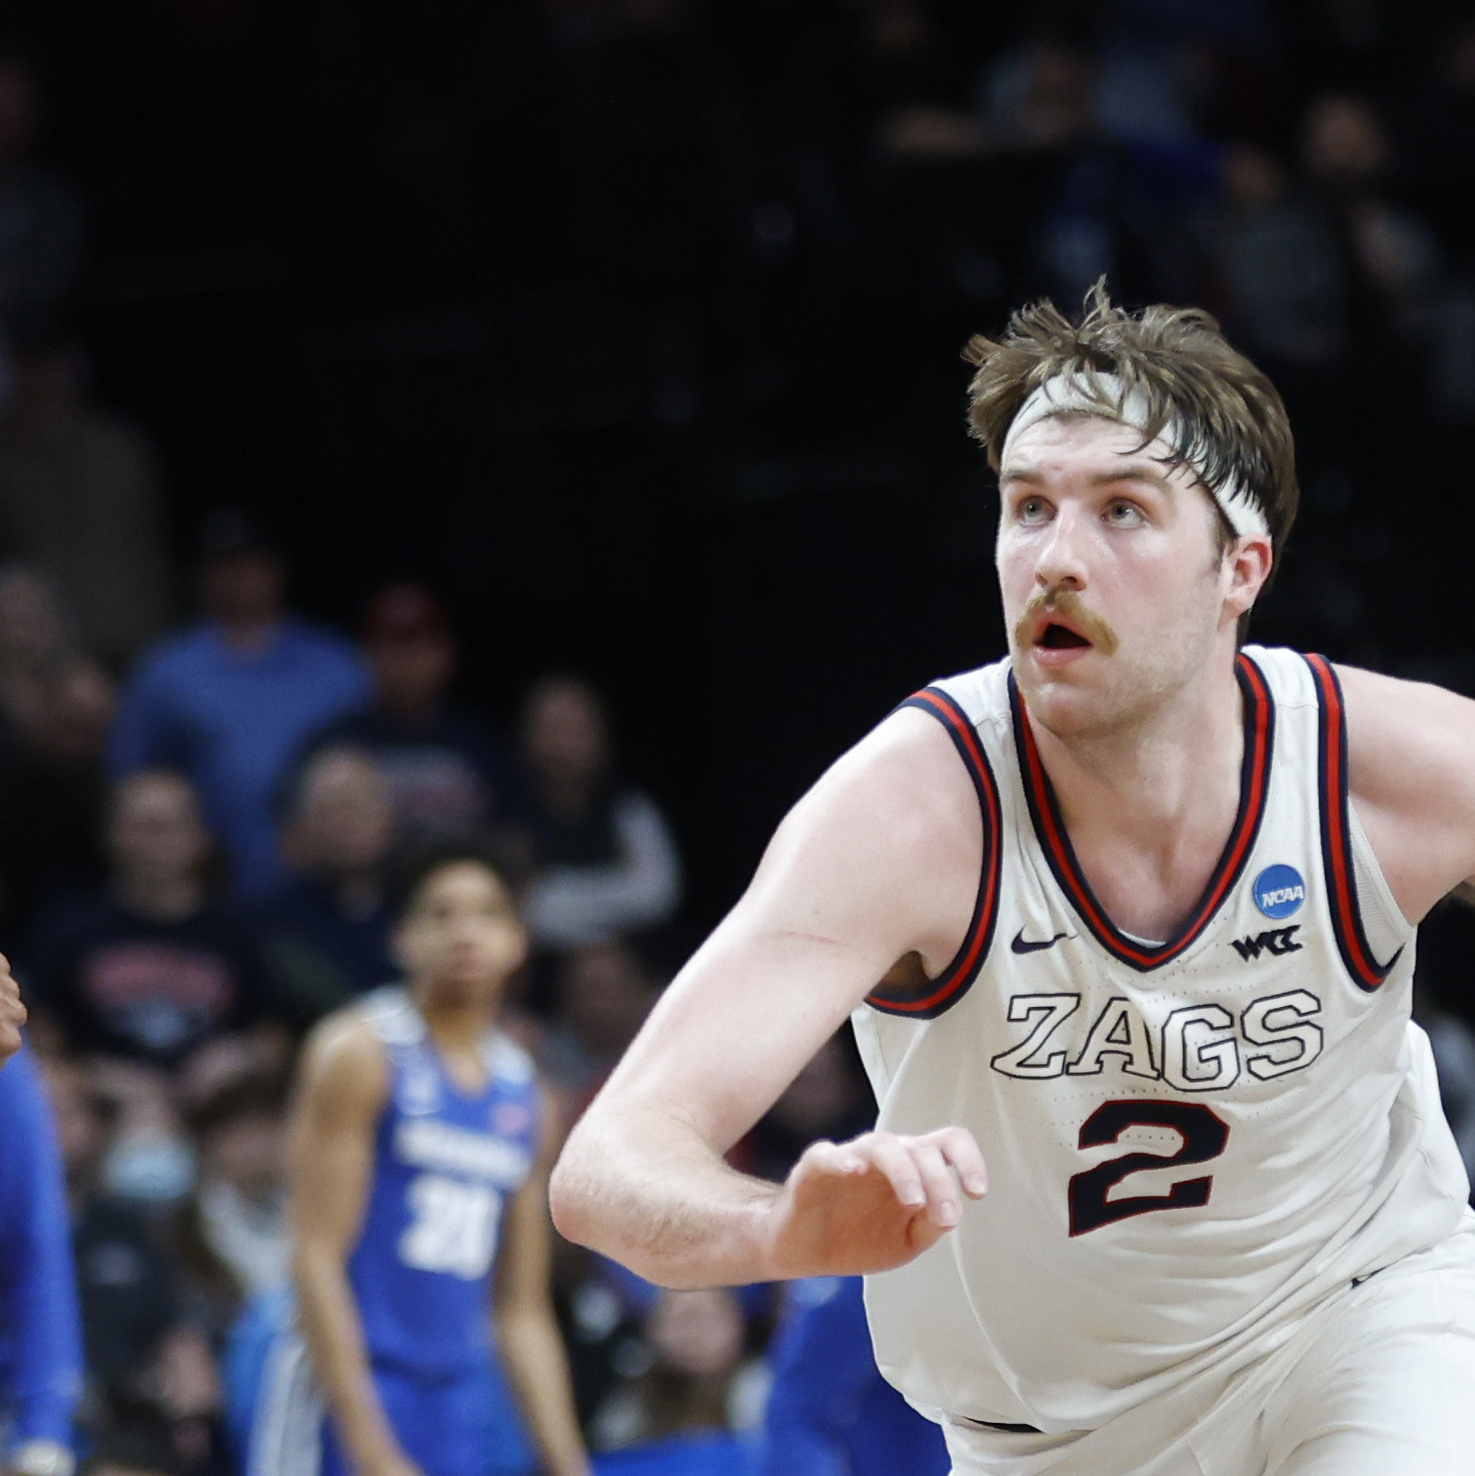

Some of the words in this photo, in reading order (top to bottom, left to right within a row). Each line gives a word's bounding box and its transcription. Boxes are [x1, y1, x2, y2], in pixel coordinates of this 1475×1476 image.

[1262, 885, 1304, 908] NCAA
[990, 988, 1325, 1093] ZAGS
[1067, 1098, 1231, 1238] 2
